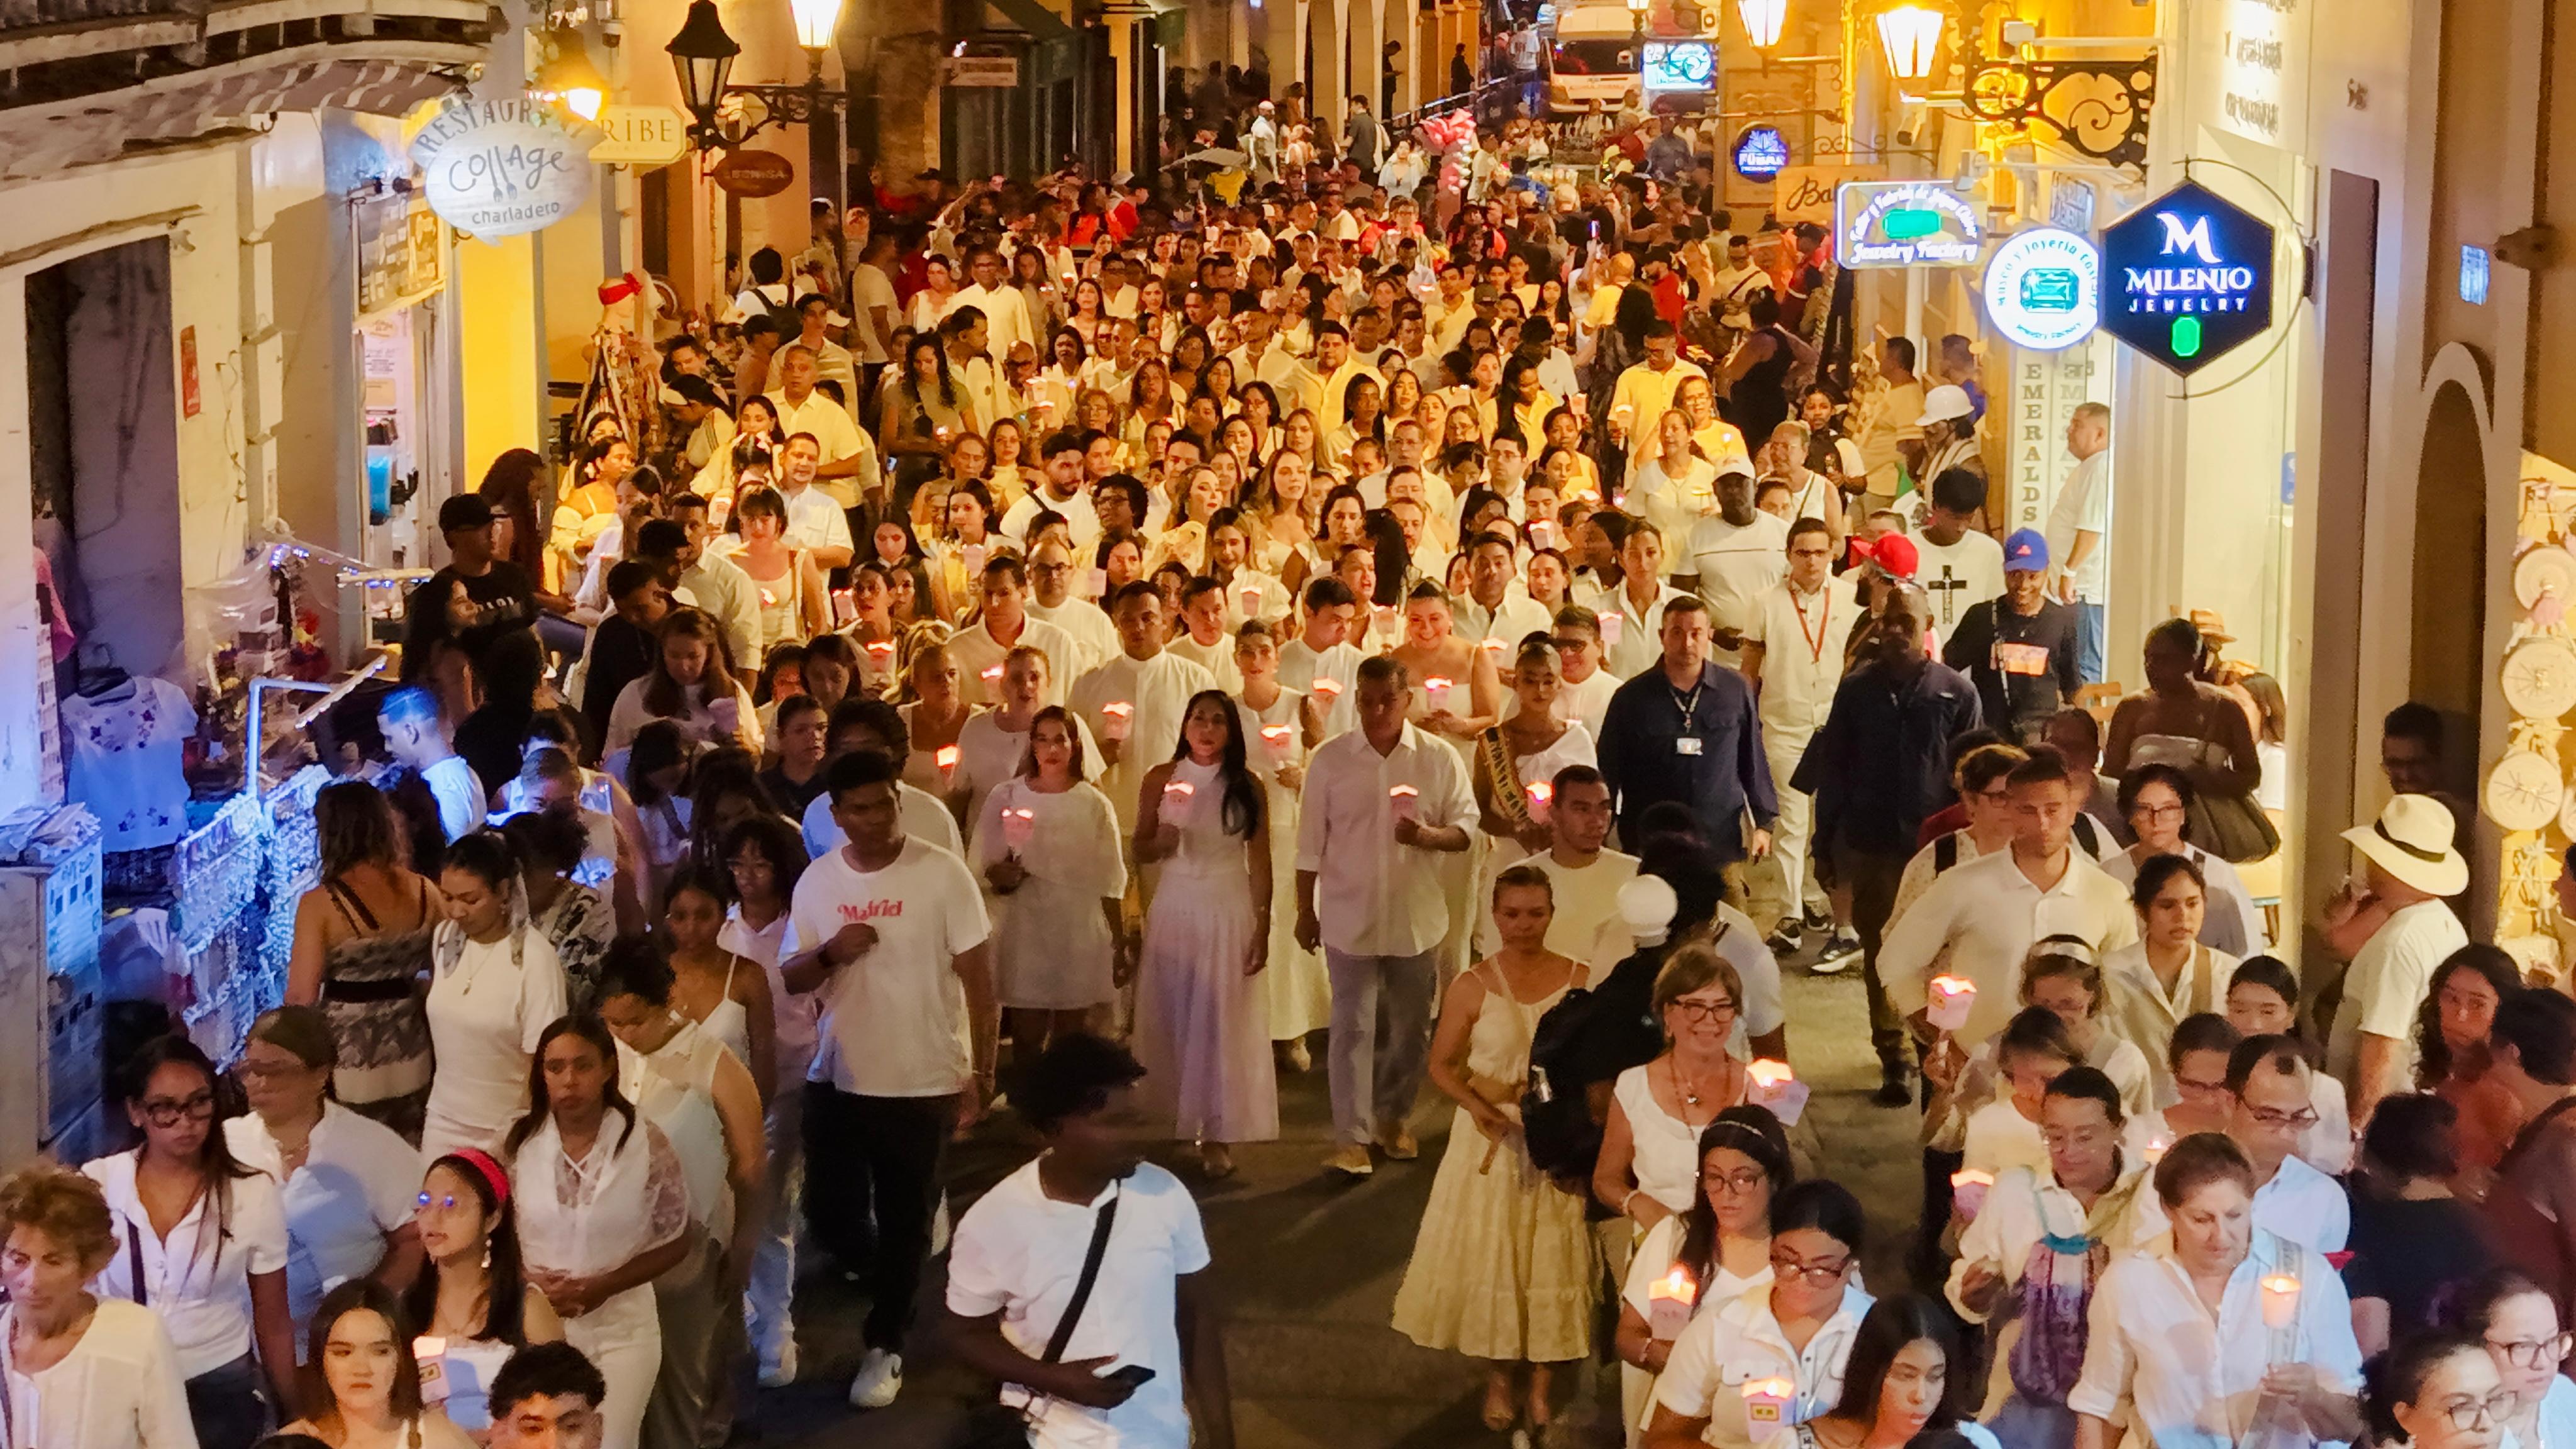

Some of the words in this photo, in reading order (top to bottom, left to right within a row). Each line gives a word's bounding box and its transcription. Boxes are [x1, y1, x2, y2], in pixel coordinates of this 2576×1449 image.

[601, 113, 674, 142] RIBE
[1850, 242, 1914, 264] Jewelry
[1916, 240, 1977, 262] Factory
[2156, 211, 2223, 264] M
[2123, 266, 2252, 296] MILENIO
[2128, 297, 2246, 313] JEWELRY
[2021, 363, 2045, 522] EMERALDS
[837, 899, 904, 922] Madrid
